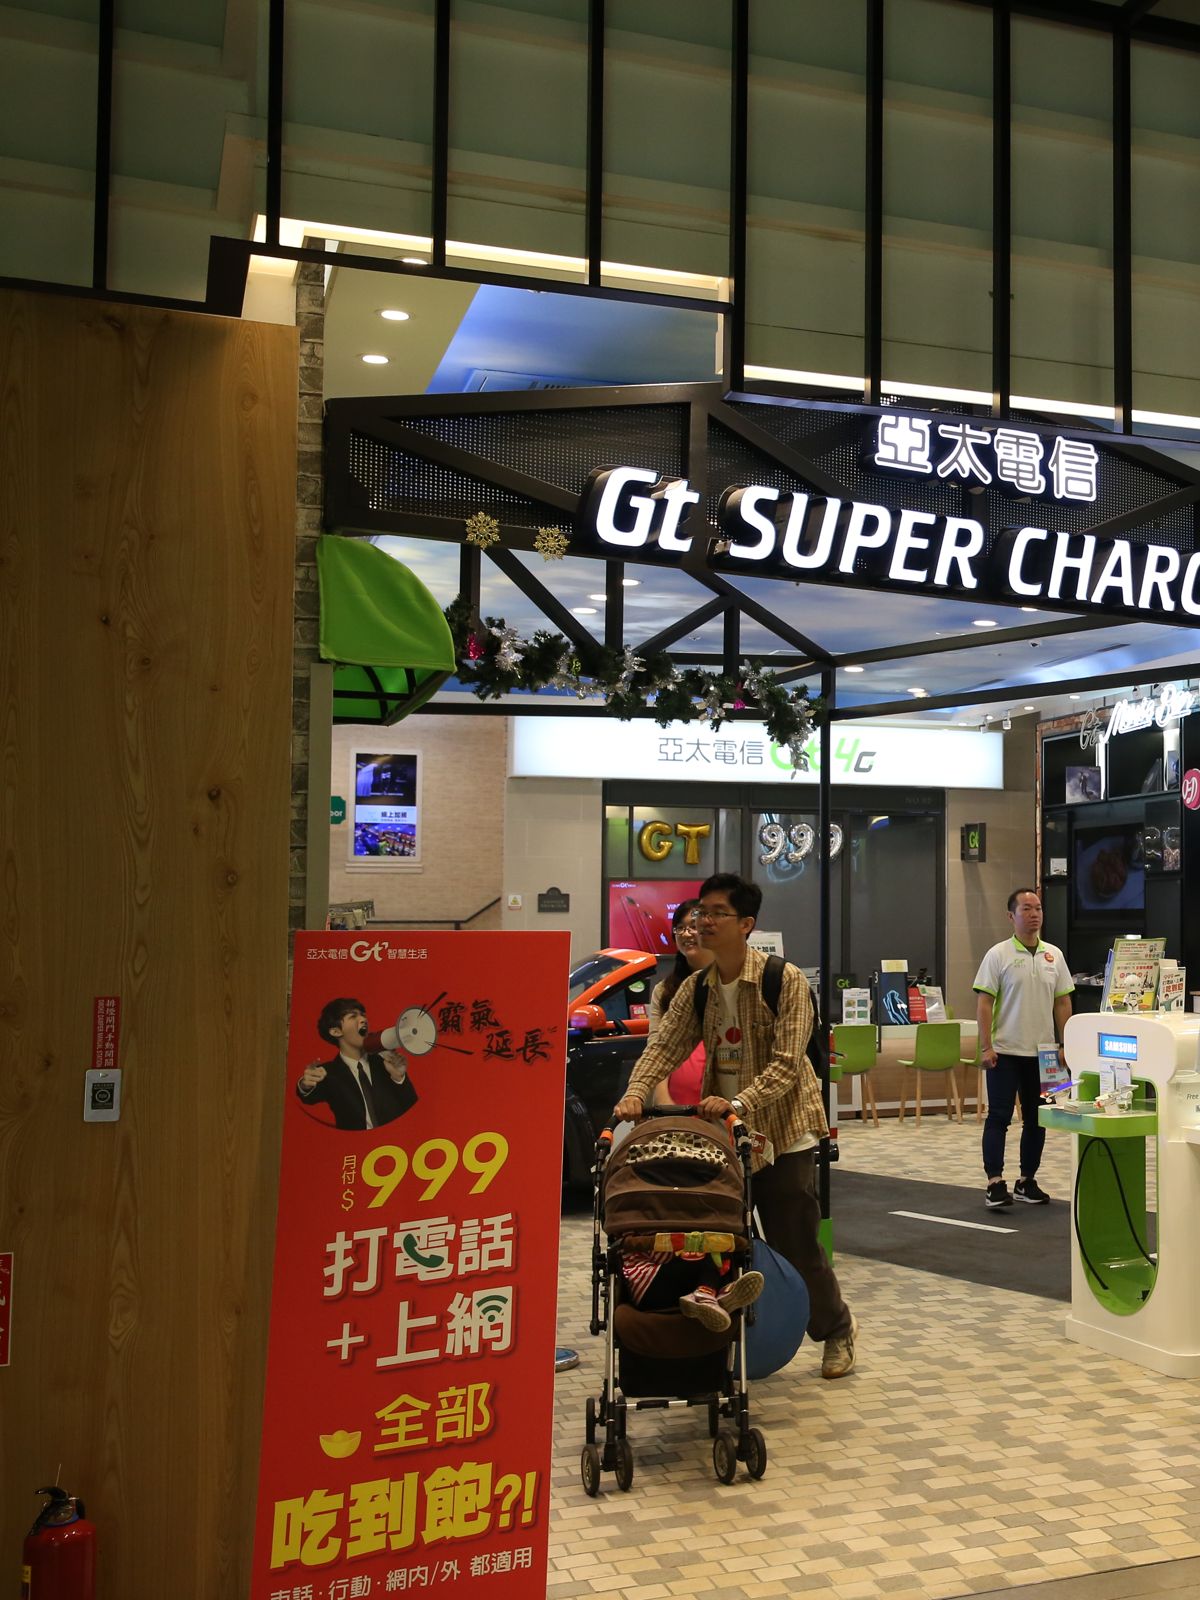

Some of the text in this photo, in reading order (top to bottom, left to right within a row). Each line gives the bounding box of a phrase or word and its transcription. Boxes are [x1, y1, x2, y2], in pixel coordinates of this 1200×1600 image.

[874, 415, 1100, 503] 亞太電信
[595, 466, 700, 552] Gt
[728, 485, 986, 589] SUPER
[657, 737, 765, 765] 亞太電信
[834, 737, 877, 773] 4G
[638, 820, 711, 866] GT
[306, 940, 428, 962] 亞太電信 Gt 智慧生活
[836, 978, 850, 988] Gt
[437, 999, 500, 1034] 霸氣
[482, 1027, 552, 1066] 延長
[1104, 1040, 1137, 1054] SAMSUNG
[341, 1154, 357, 1185] 月付
[361, 1131, 509, 1209] 999
[323, 1212, 514, 1297] 打電話
[373, 1382, 492, 1452] 全部
[469, 1546, 533, 1577] 都適用
